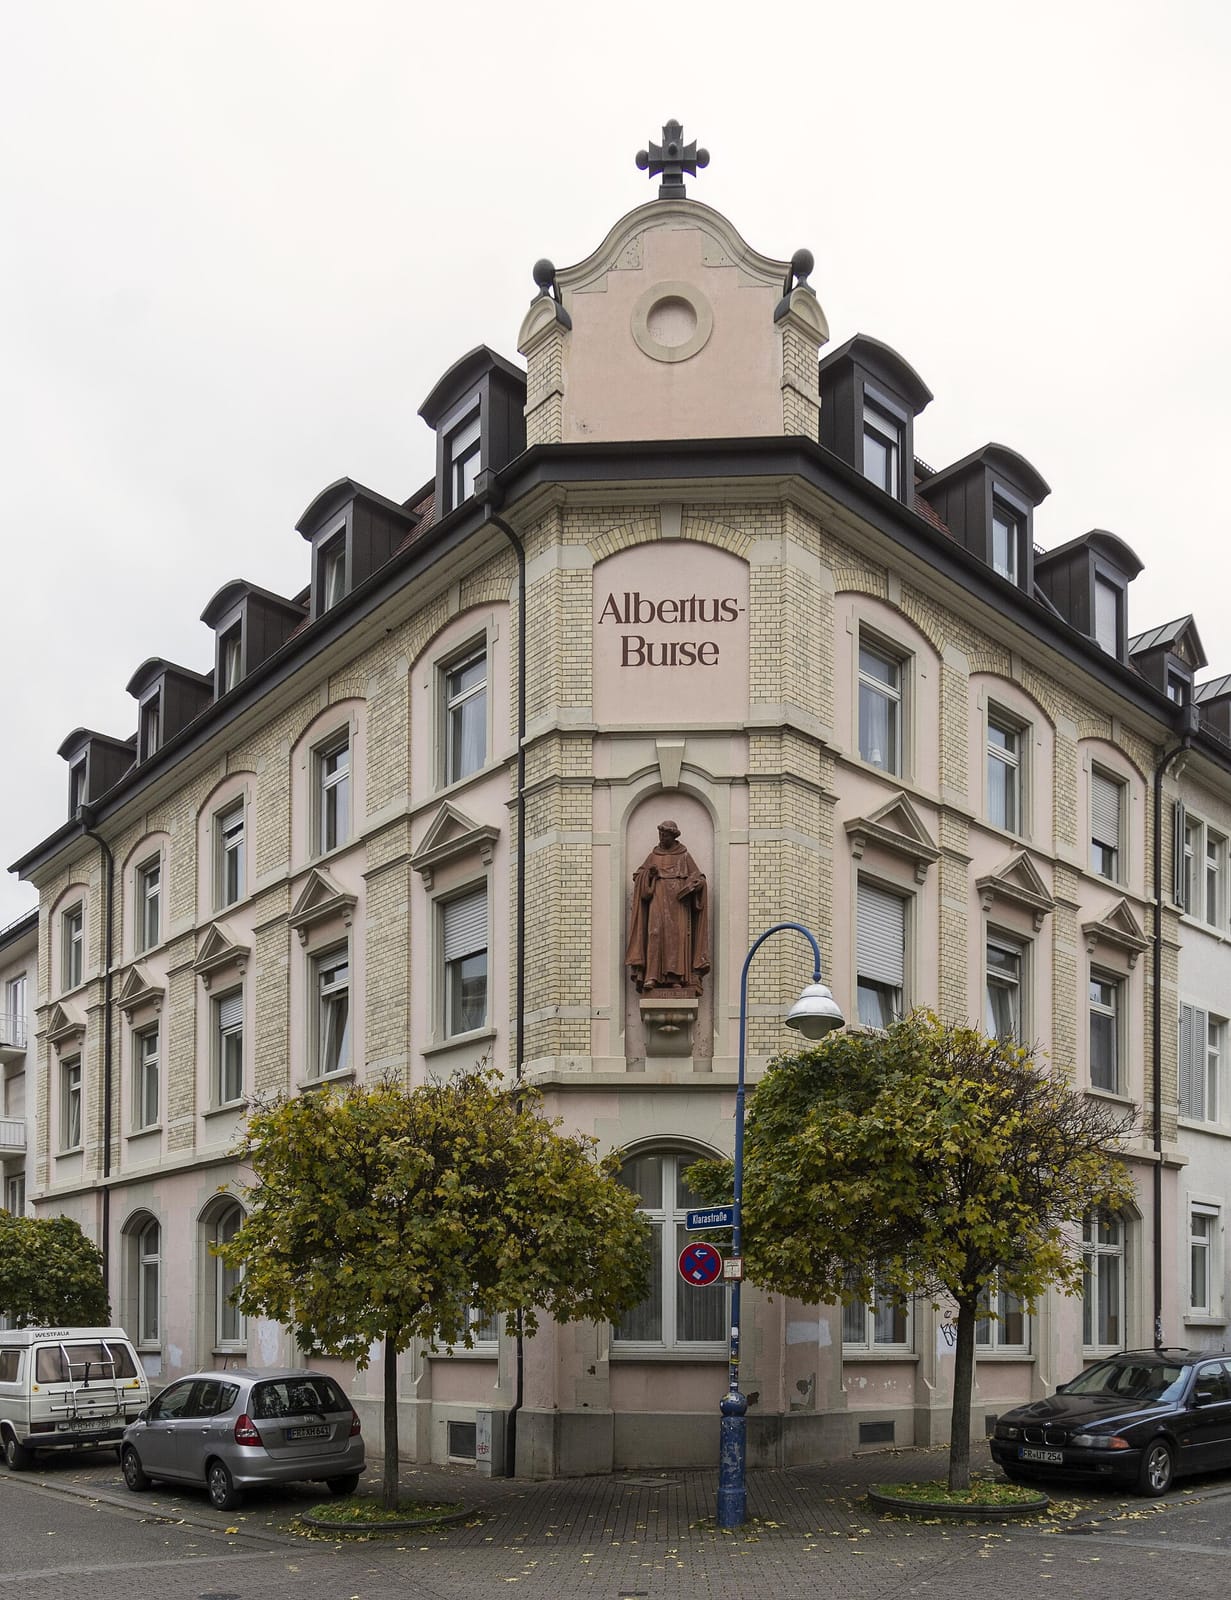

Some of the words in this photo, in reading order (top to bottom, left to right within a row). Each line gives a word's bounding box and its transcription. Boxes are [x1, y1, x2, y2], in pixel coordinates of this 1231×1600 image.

[597, 591, 746, 624] Albertus-
[620, 635, 720, 667] Burse
[692, 1211, 728, 1225] Klarastraße
